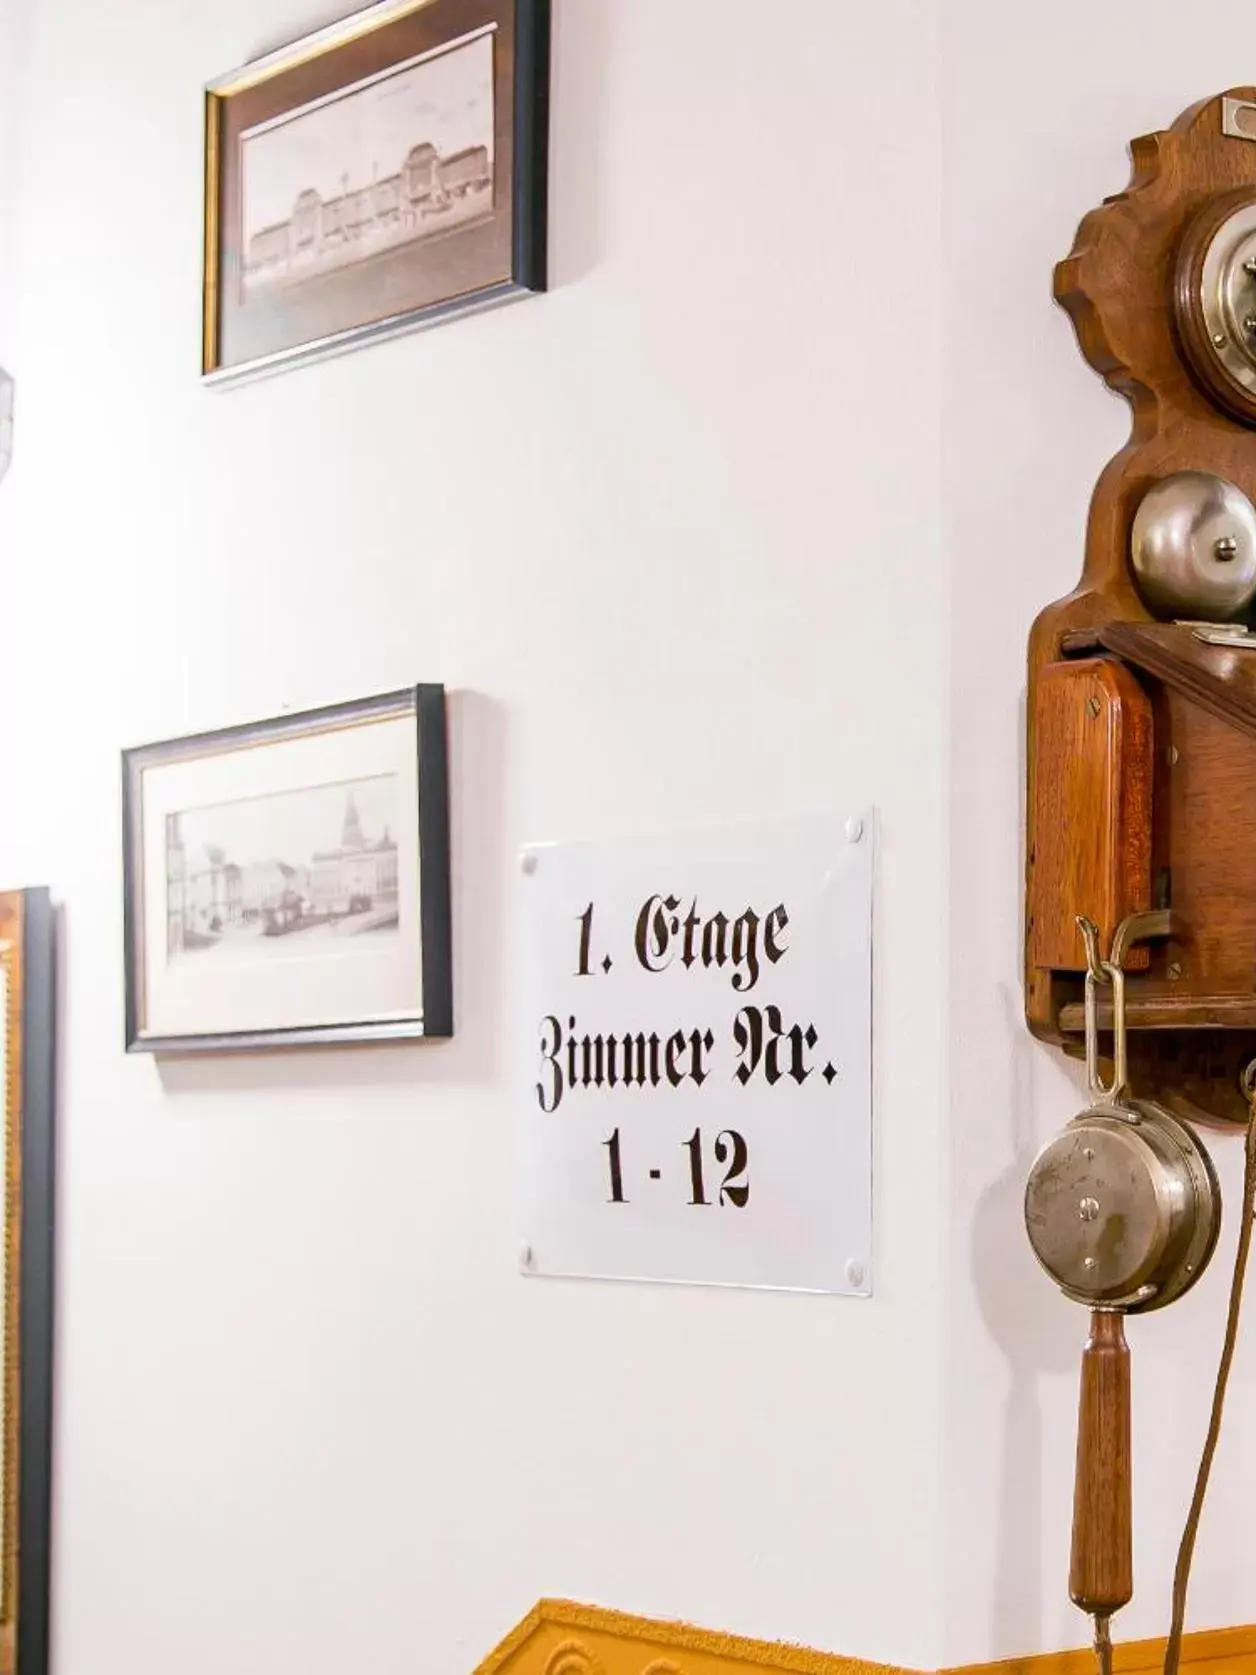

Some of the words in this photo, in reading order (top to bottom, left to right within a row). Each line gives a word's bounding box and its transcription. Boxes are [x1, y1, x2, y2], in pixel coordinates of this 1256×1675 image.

[574, 901, 613, 976] 1.
[634, 893, 790, 992] Etage
[535, 1014, 715, 1113] Zimmer
[732, 1004, 838, 1087] Nr.
[601, 1127, 631, 1204] 1
[681, 1126, 750, 1209] 12
